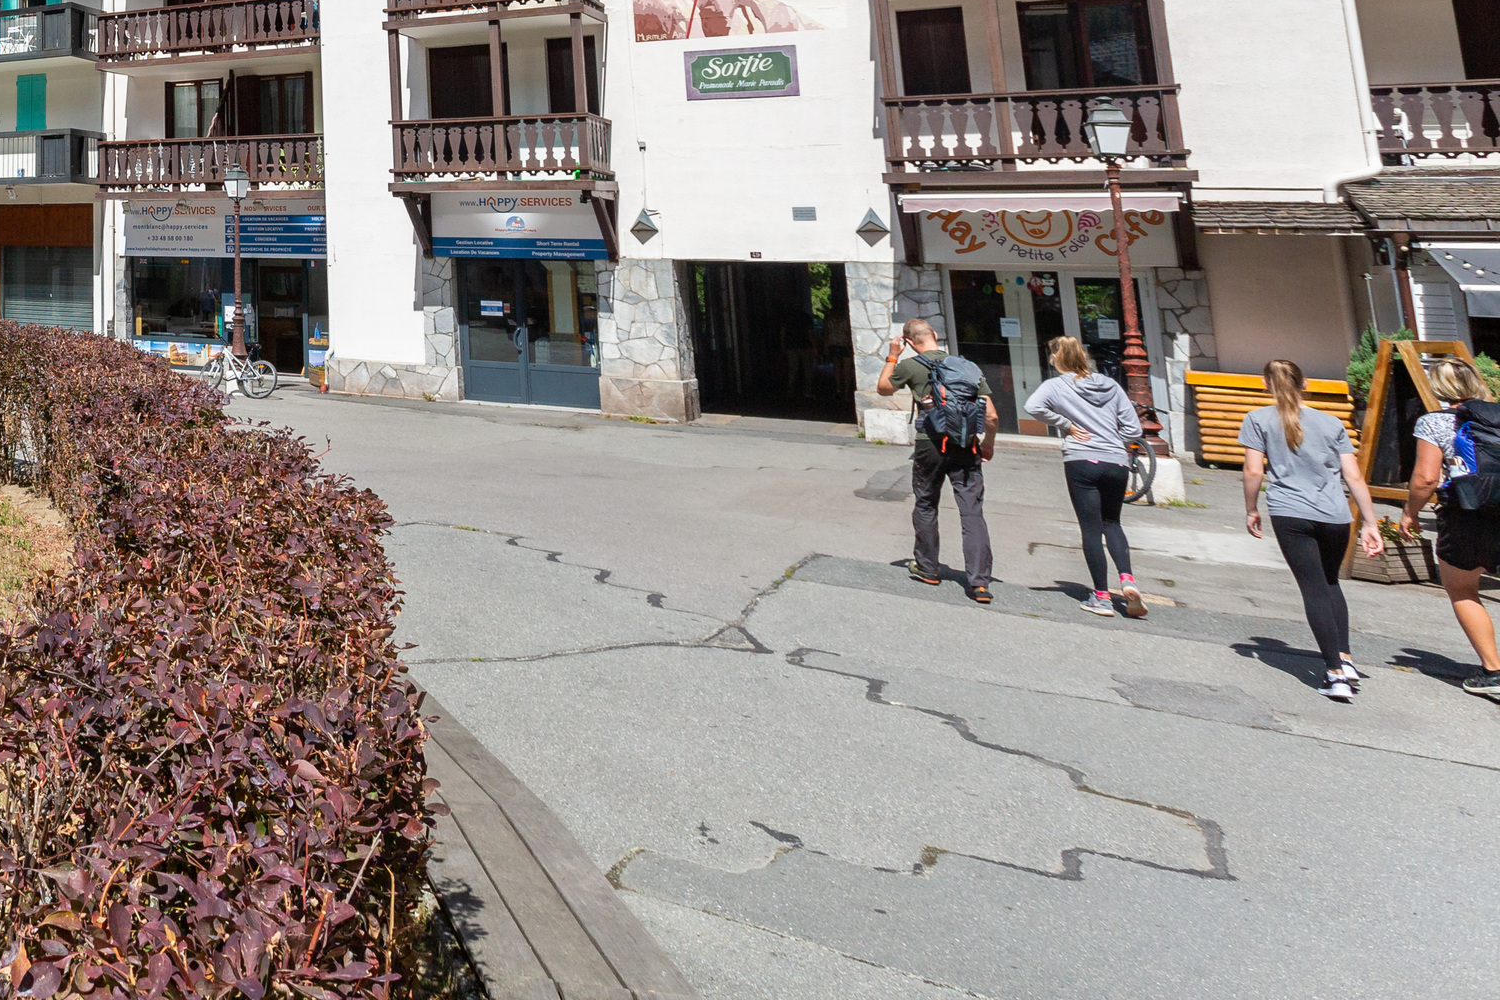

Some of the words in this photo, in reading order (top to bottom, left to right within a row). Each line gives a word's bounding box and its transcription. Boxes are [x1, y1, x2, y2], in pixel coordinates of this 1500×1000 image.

[701, 52, 774, 80] Sortie
[699, 80, 734, 90] Promenade
[736, 79, 757, 88] Marie
[758, 78, 785, 87] Paradis
[989, 228, 1007, 246] La
[1008, 243, 1054, 261] Petite
[1058, 233, 1090, 259] Folie
